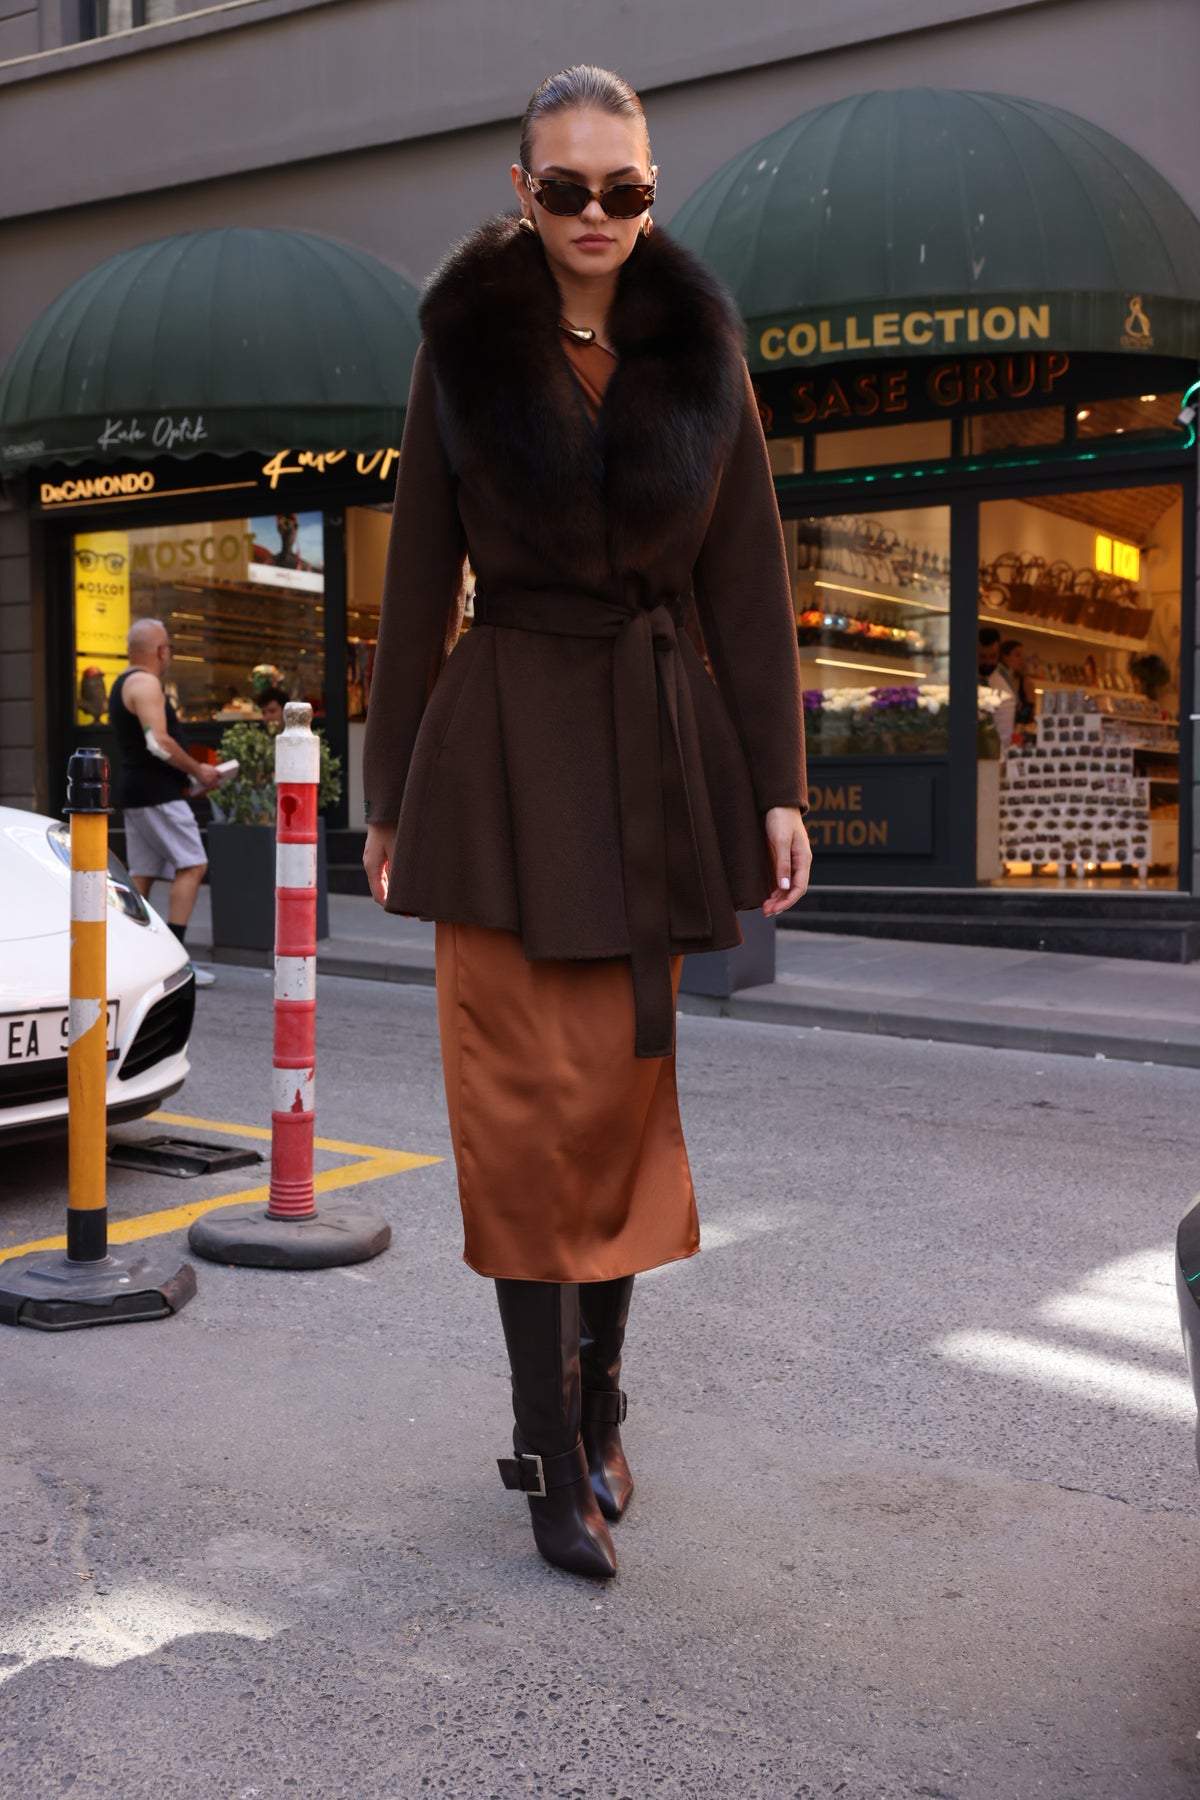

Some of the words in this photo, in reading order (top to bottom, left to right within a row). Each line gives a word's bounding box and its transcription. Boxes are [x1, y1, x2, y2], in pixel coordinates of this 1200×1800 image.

[759, 304, 1050, 361] COLLECTION
[791, 368, 908, 424] SASE
[928, 351, 1070, 408] GRUP
[152, 415, 208, 449] Optik
[130, 531, 257, 573] MOSCOT
[76, 582, 125, 597] MOSCOT
[806, 784, 863, 812] OME
[8, 1020, 39, 1059] EA
